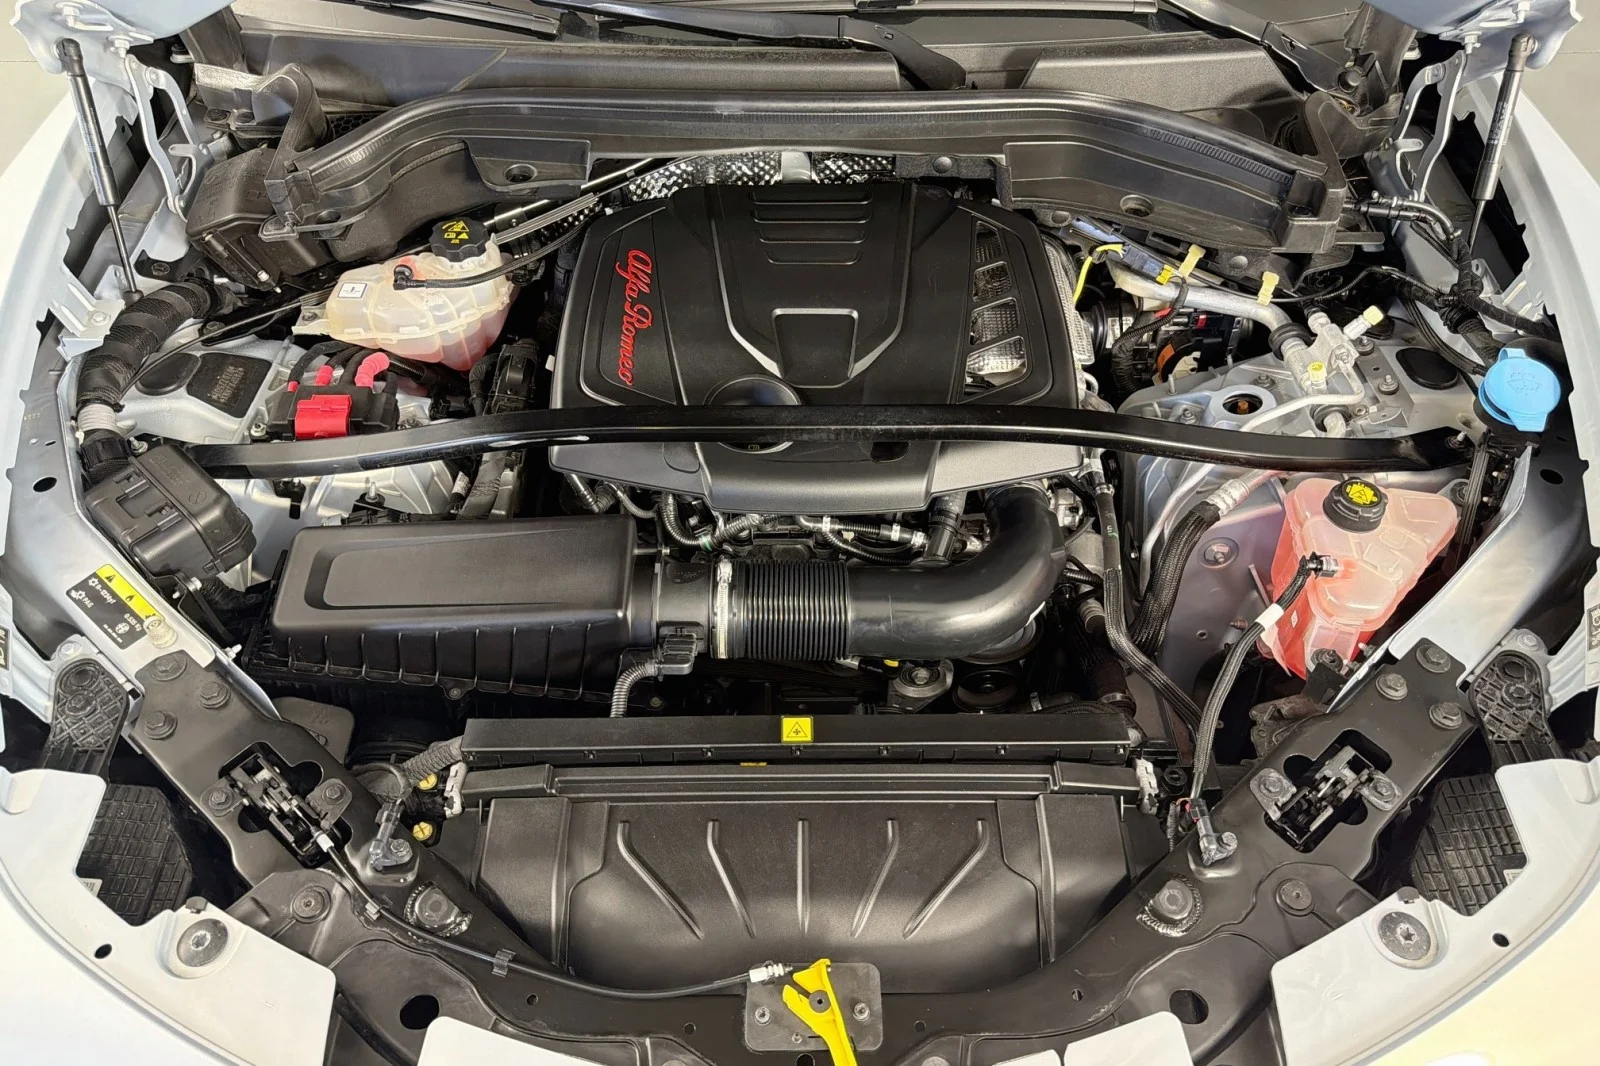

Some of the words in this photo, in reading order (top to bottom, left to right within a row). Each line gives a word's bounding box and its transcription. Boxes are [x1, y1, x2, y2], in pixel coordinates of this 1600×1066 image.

[615, 249, 653, 302] Alfa
[618, 301, 653, 385] Romeo
[83, 596, 94, 608] PAG
